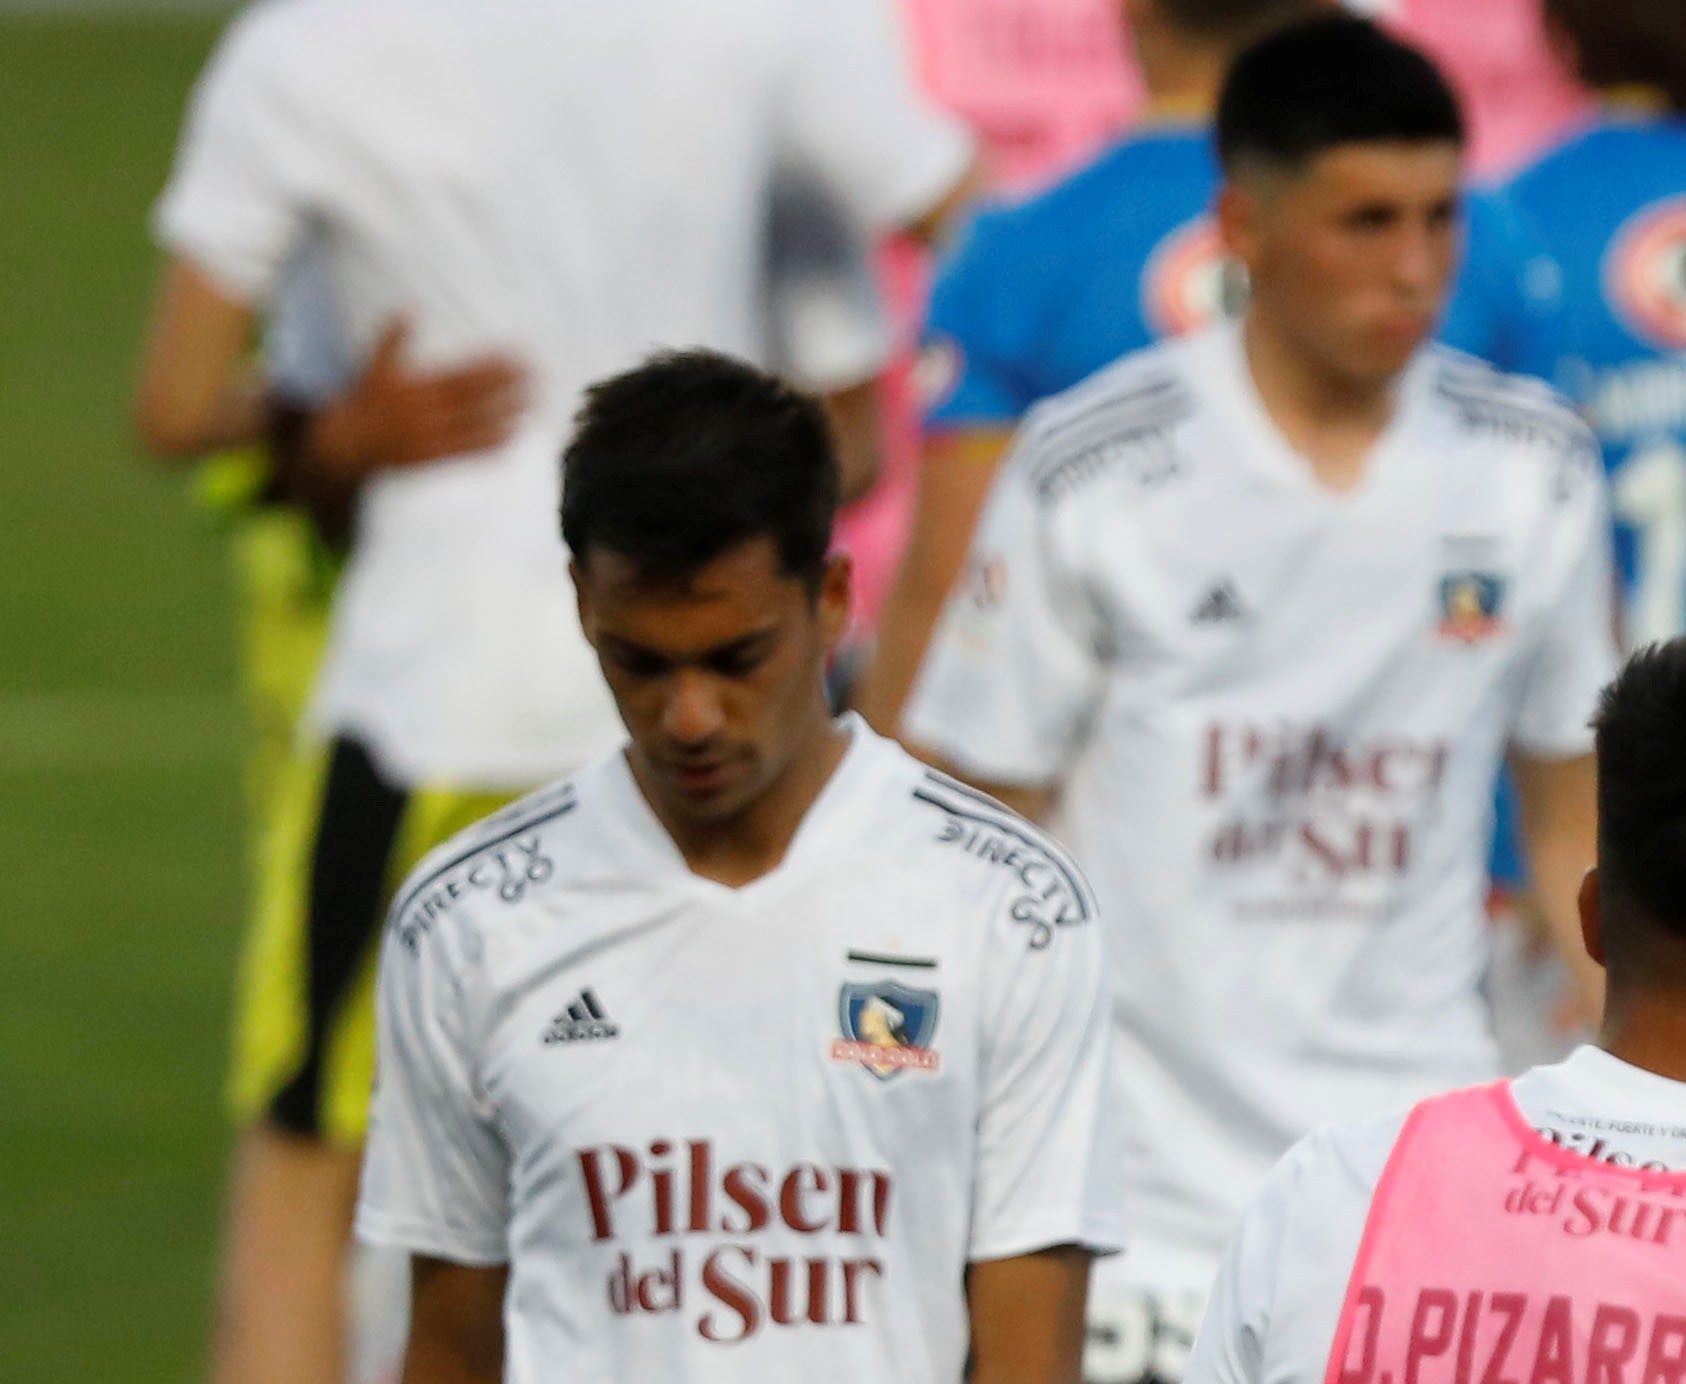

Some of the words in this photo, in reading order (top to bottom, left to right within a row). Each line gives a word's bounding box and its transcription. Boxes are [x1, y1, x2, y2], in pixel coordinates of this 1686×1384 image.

[936, 815, 1088, 926] DIRECTV
[575, 1136, 892, 1243] Pilsen
[1504, 1182, 1567, 1216] del
[608, 1249, 684, 1316] del
[697, 1244, 885, 1344] Sur
